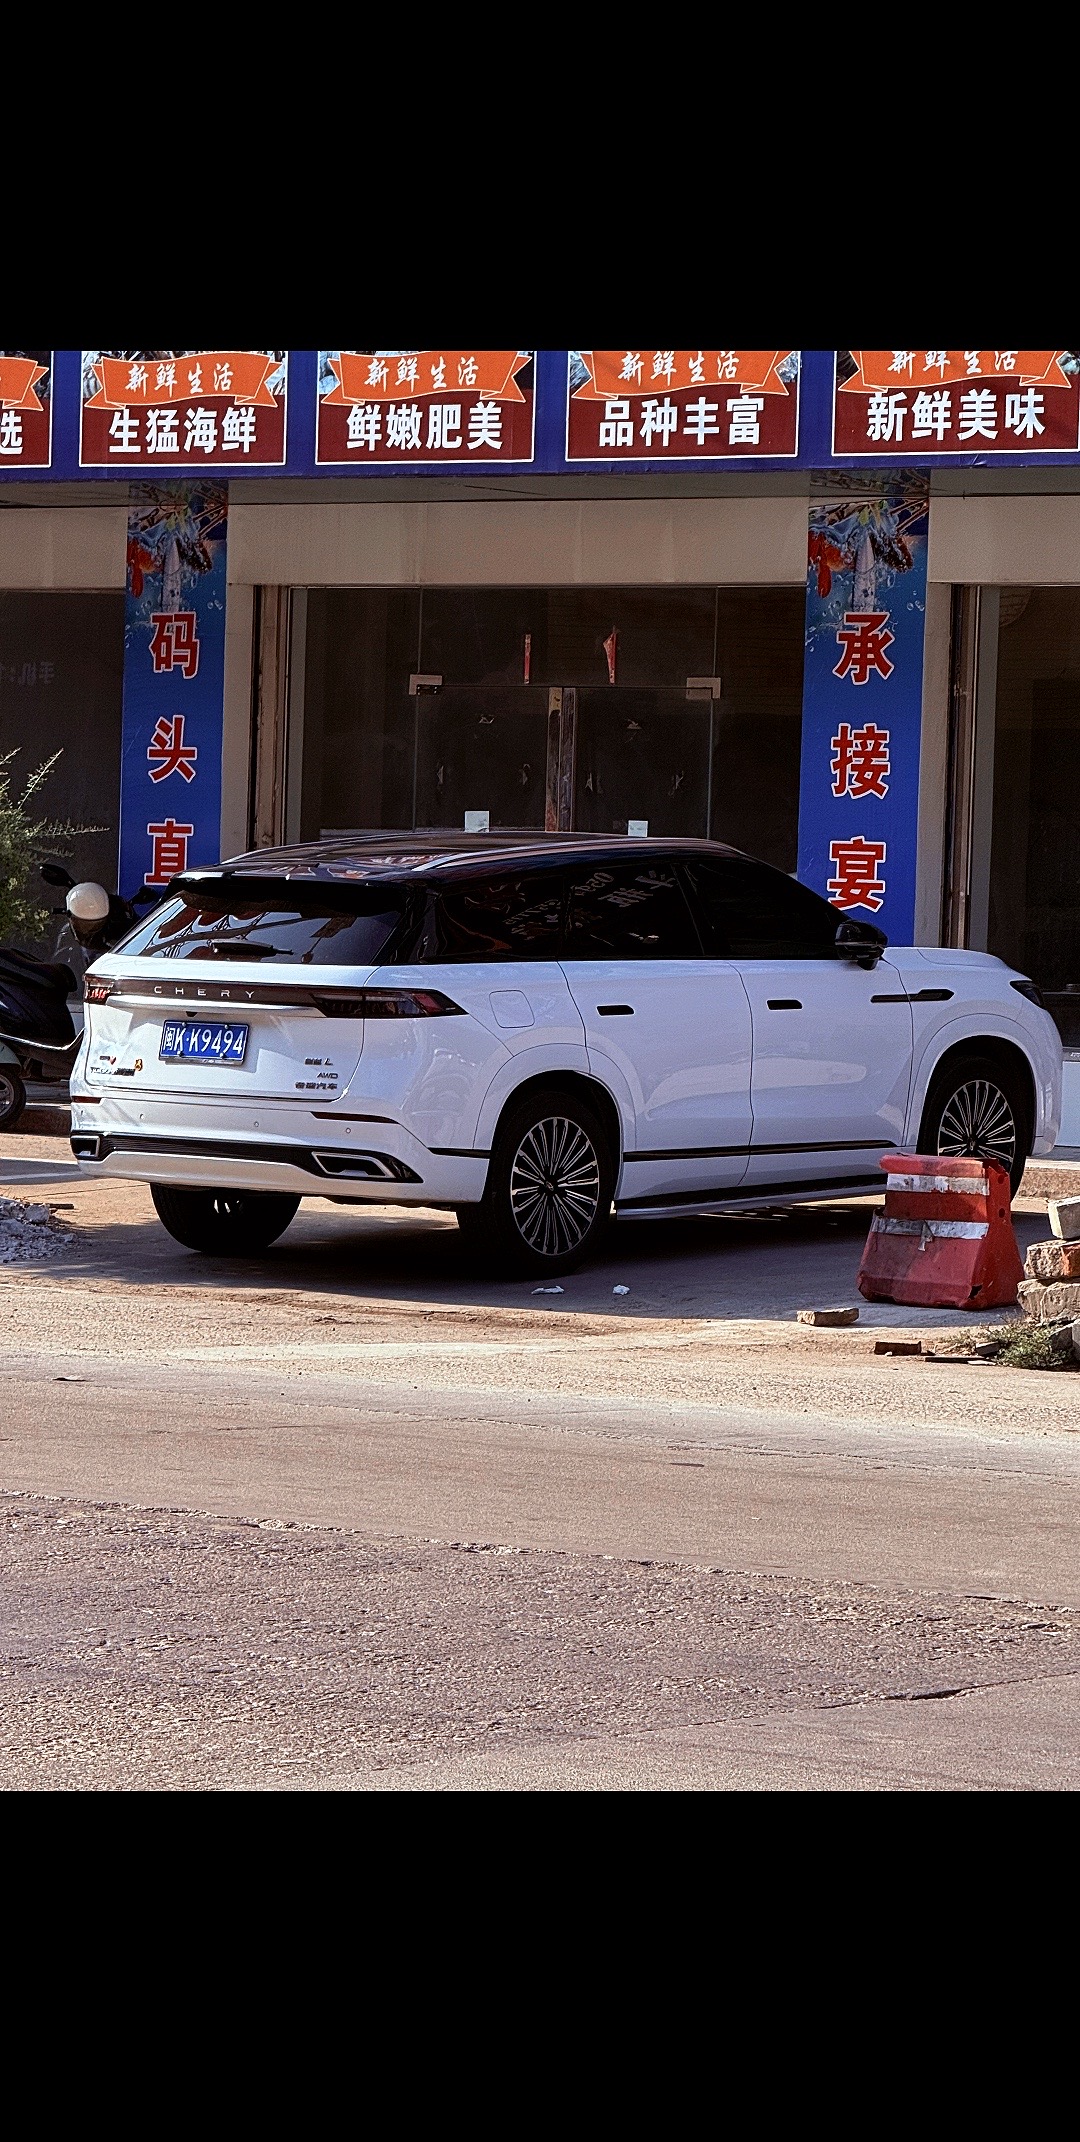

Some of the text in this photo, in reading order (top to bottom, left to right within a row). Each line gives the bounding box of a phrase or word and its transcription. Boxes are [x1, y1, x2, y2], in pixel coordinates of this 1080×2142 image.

[125, 361, 234, 398] 新鲜生活
[363, 355, 480, 392] 新鲜生活
[617, 351, 740, 387] 新鲜生活
[108, 408, 257, 454] 生猛海鲜
[345, 401, 504, 452] 鲜嫩肥美
[598, 396, 765, 447] 品种丰富
[866, 388, 1046, 442] 新鲜美味
[144, 611, 200, 887] 码头直
[827, 611, 896, 913] 承接宴
[153, 985, 257, 1000] CHERY
[316, 1072, 339, 1080] AWD
